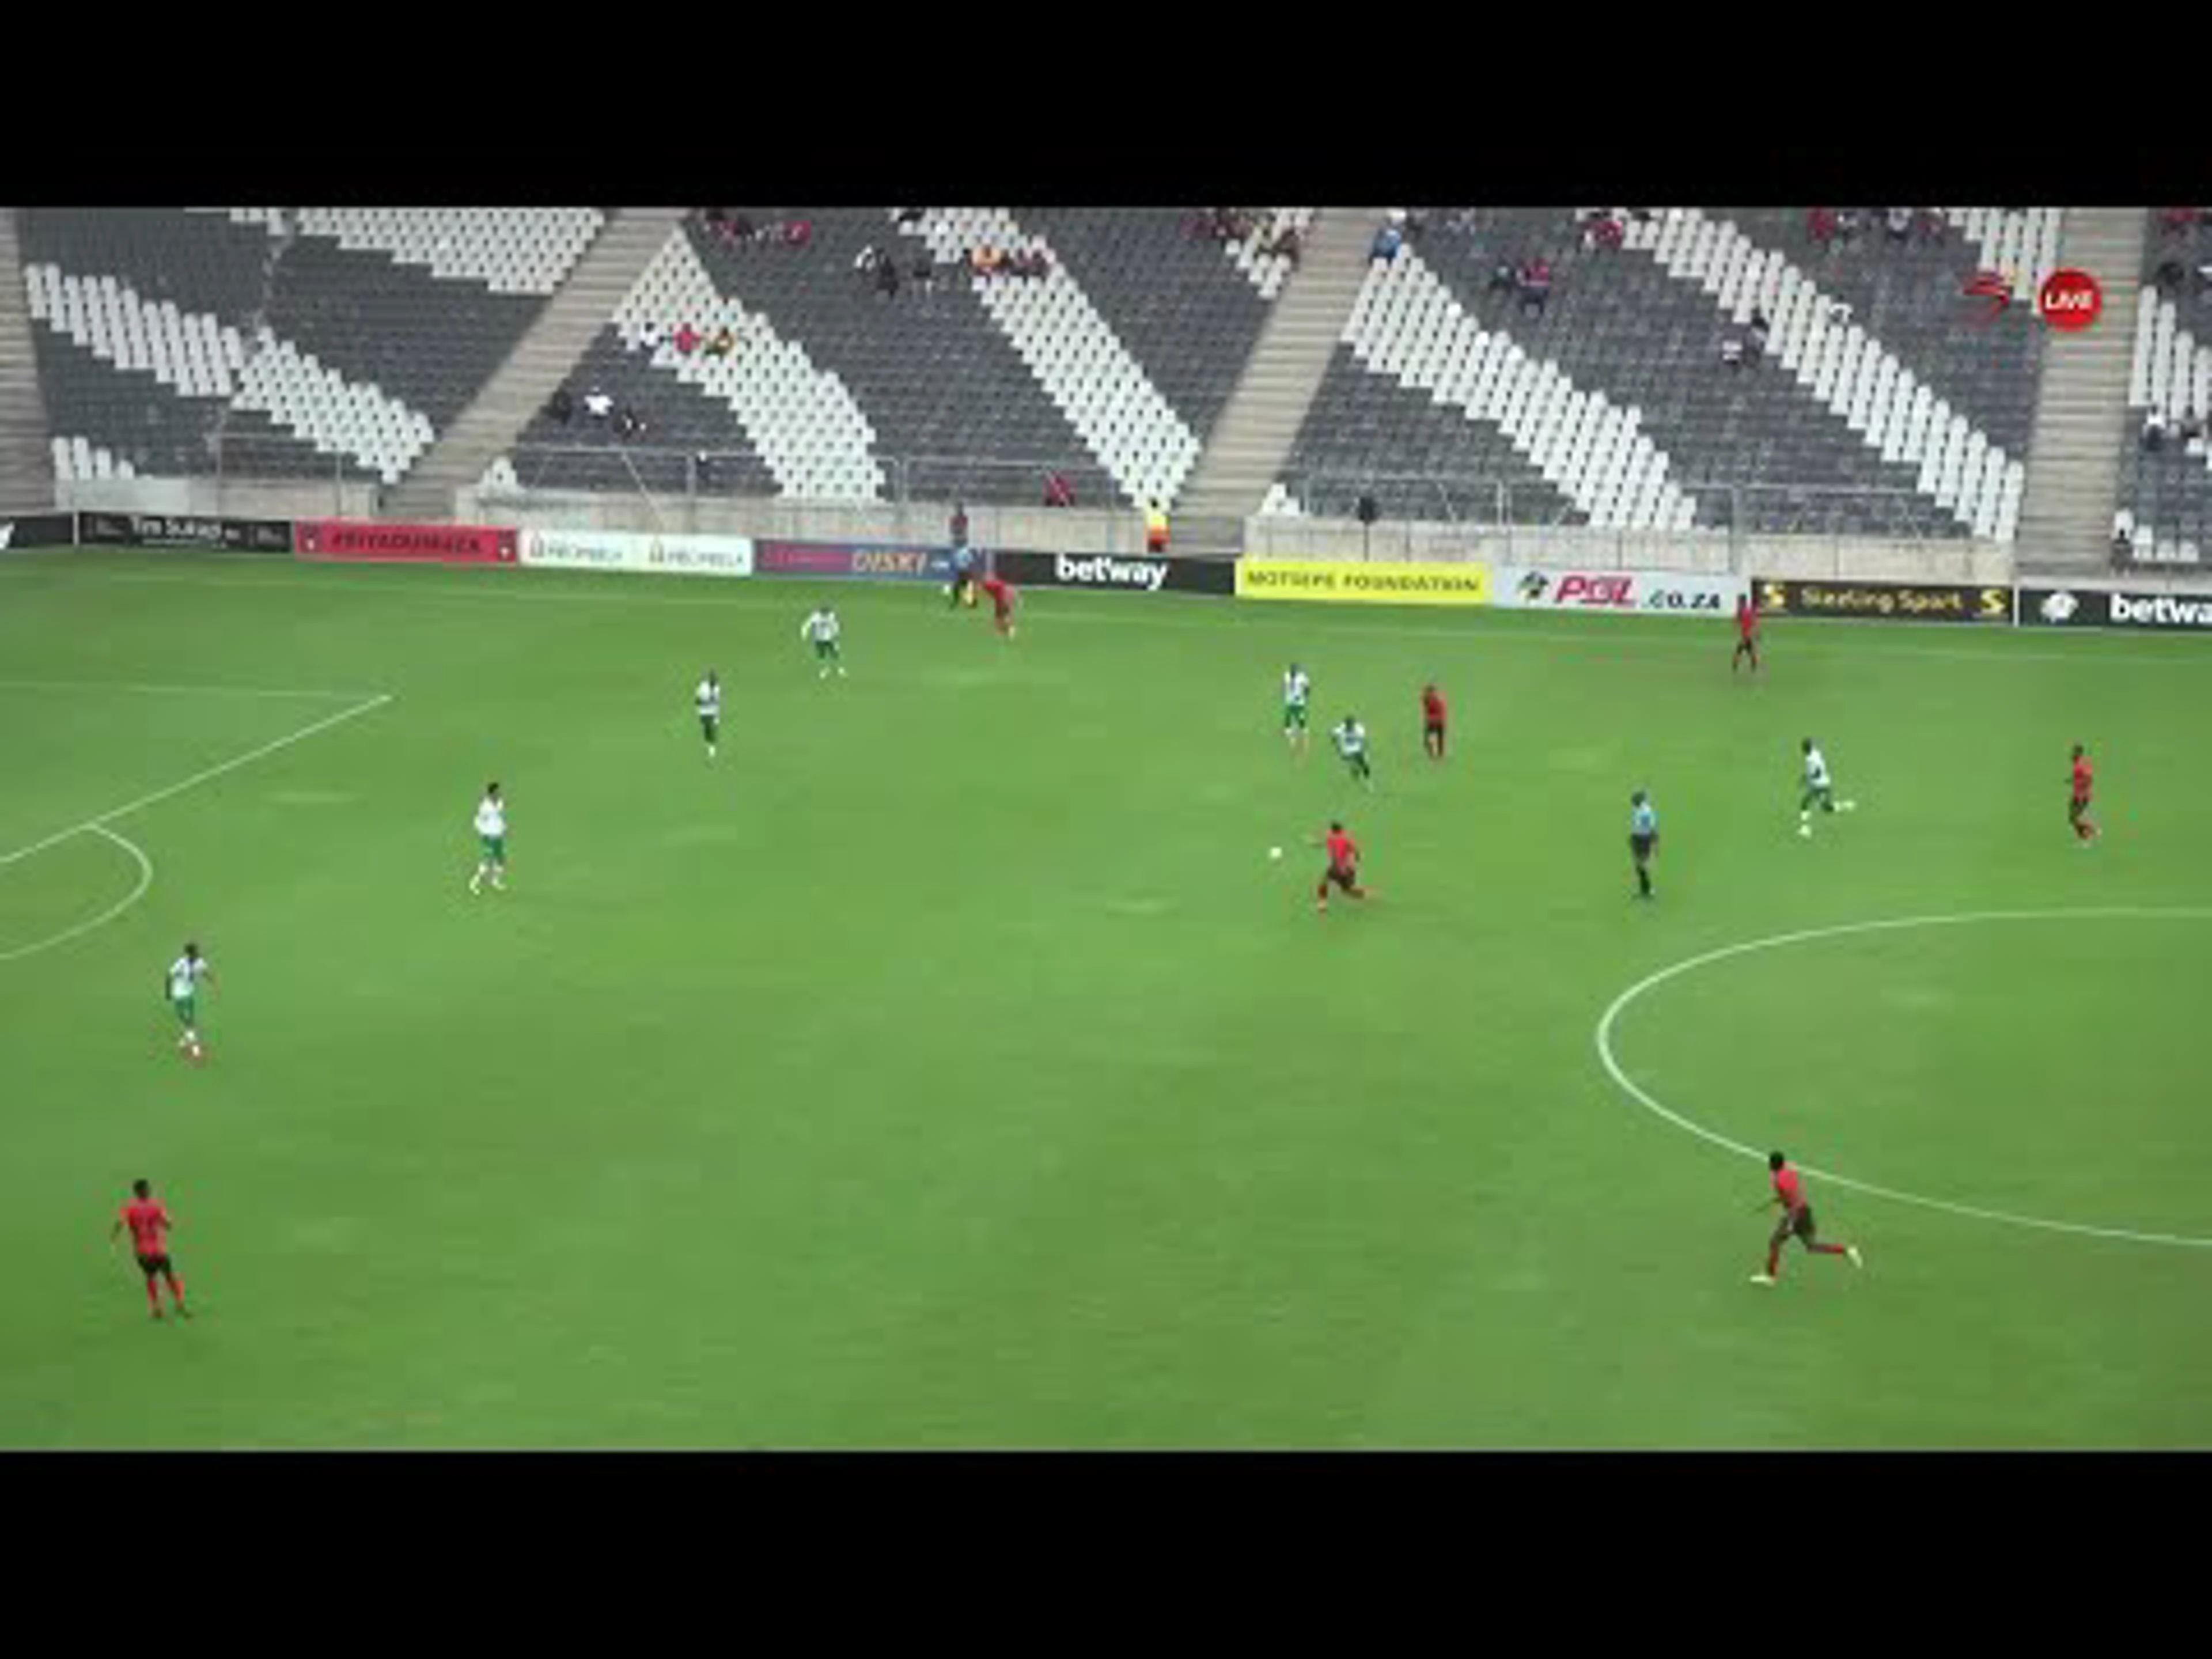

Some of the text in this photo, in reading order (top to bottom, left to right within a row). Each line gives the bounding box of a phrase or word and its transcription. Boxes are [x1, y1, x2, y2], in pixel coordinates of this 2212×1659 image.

[1055, 553, 1168, 591] betway
[1247, 570, 1479, 591] MOTSEPE FOUNDATION
[1897, 589, 1961, 613] Sport
